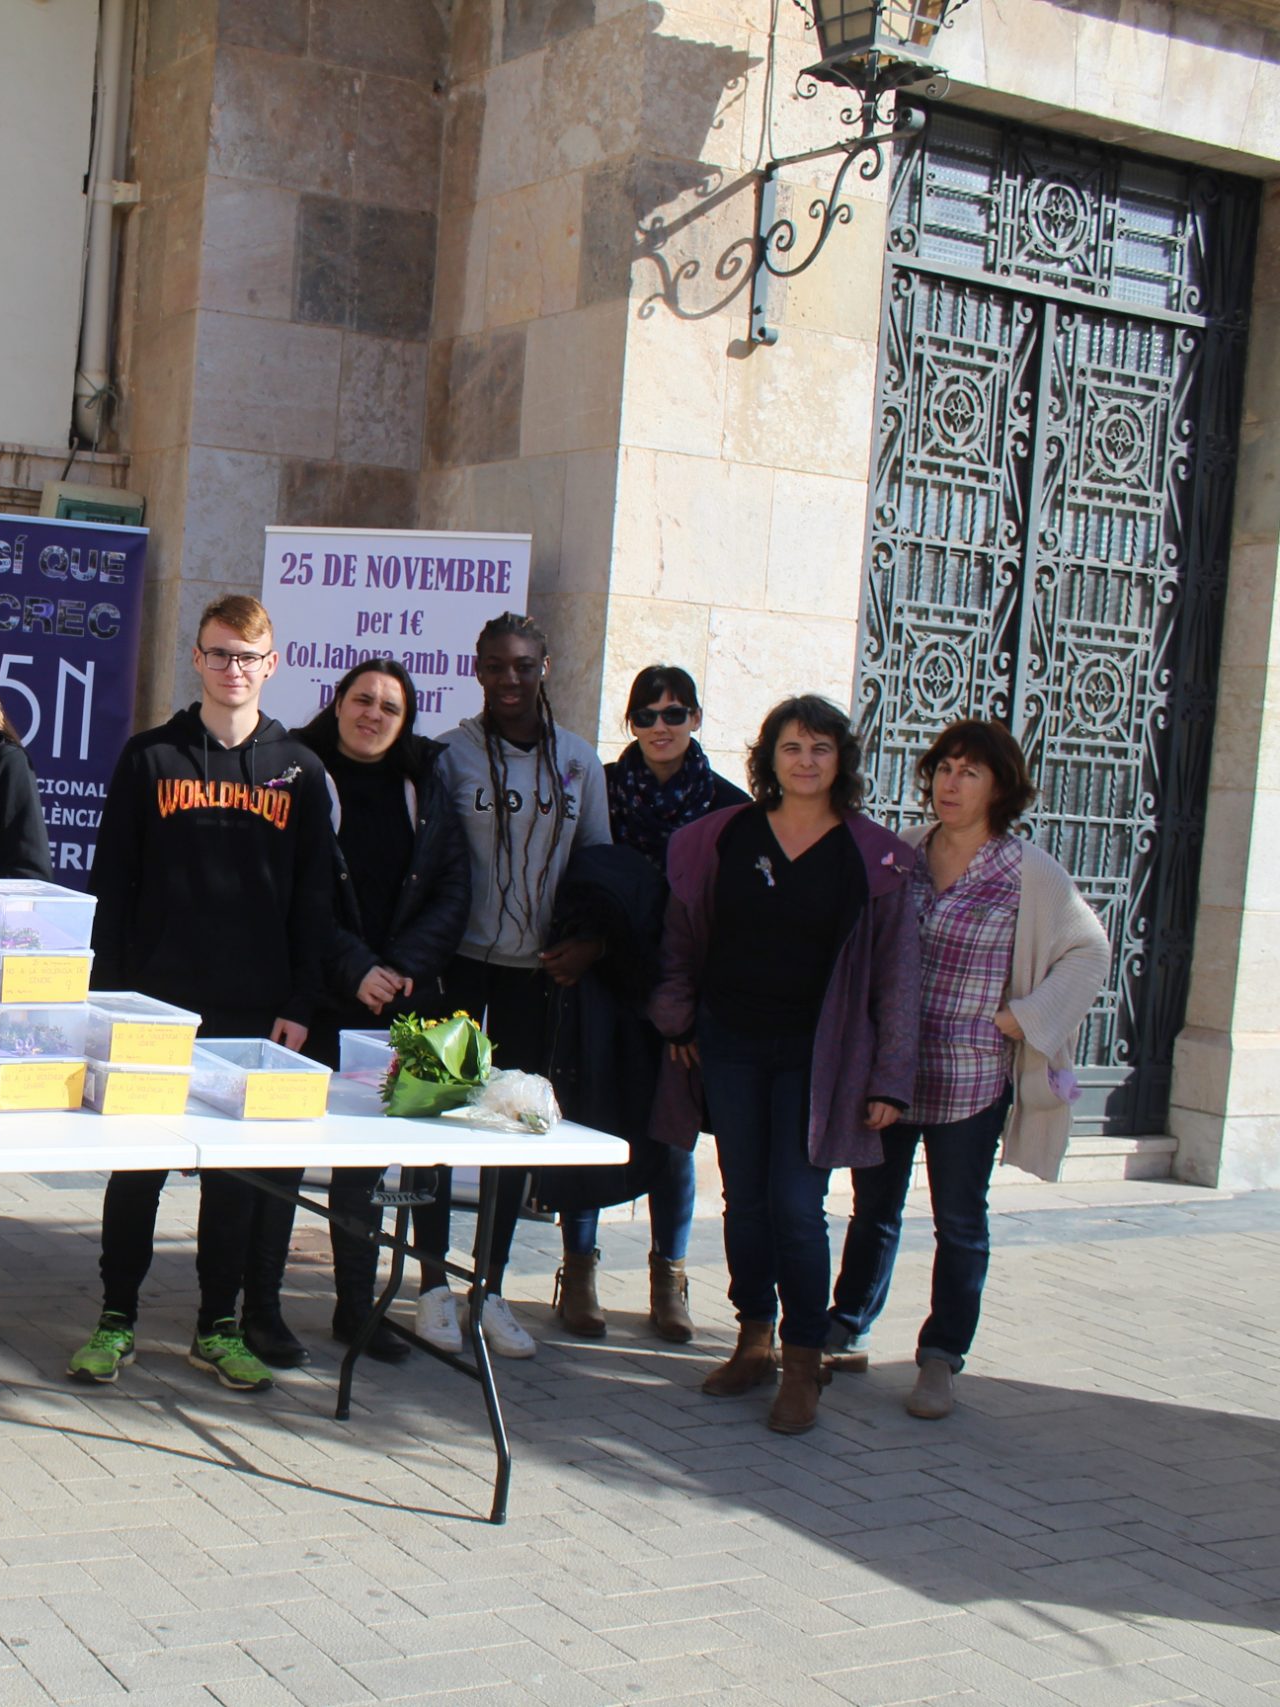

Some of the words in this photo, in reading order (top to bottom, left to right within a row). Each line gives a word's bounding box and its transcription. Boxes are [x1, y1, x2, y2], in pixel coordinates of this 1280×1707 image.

[39, 545, 127, 584] QUE
[279, 552, 313, 585] 25
[322, 553, 357, 587] DE
[365, 555, 511, 594] NOVEMBRE
[356, 611, 392, 637] per
[399, 609, 424, 637] 1€
[402, 649, 449, 677] amb
[36, 778, 108, 798] CIONAL
[157, 779, 292, 831] WORLDHOOD
